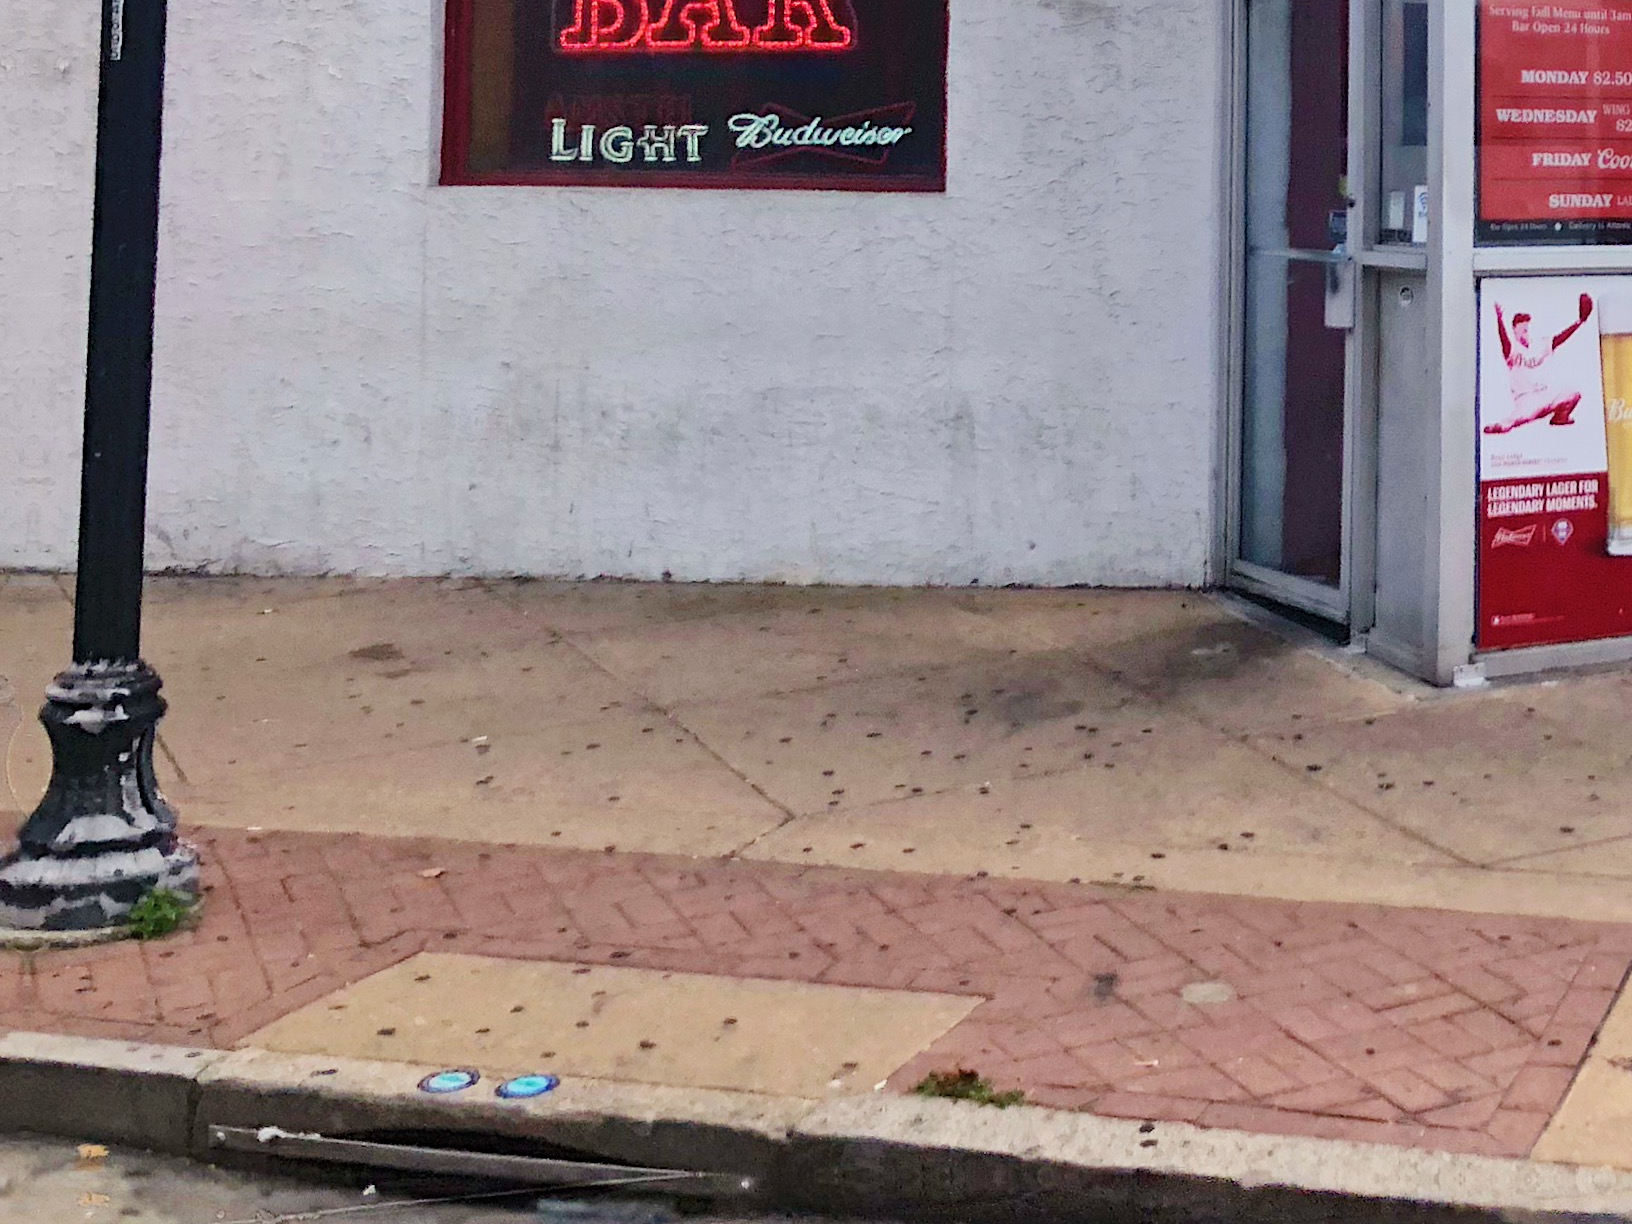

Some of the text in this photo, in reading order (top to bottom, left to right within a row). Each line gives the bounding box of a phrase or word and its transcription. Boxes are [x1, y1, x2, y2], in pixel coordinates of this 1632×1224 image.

[1489, 4, 1529, 19] Serving
[1552, 6, 1581, 19] Menu
[1512, 20, 1610, 35] Bar Open 24 Hours
[1521, 69, 1589, 85] MONDAY
[1496, 108, 1598, 124] WEDNESDAY
[1603, 104, 1630, 116] WING
[550, 113, 913, 163] LIGHT Budweiser
[1532, 152, 1592, 167] FRIDAY
[1548, 193, 1614, 208] SUNDAY
[1487, 479, 1599, 502] LEGENDARY LAGER FOR
[1487, 496, 1545, 518] LEGENDARY
